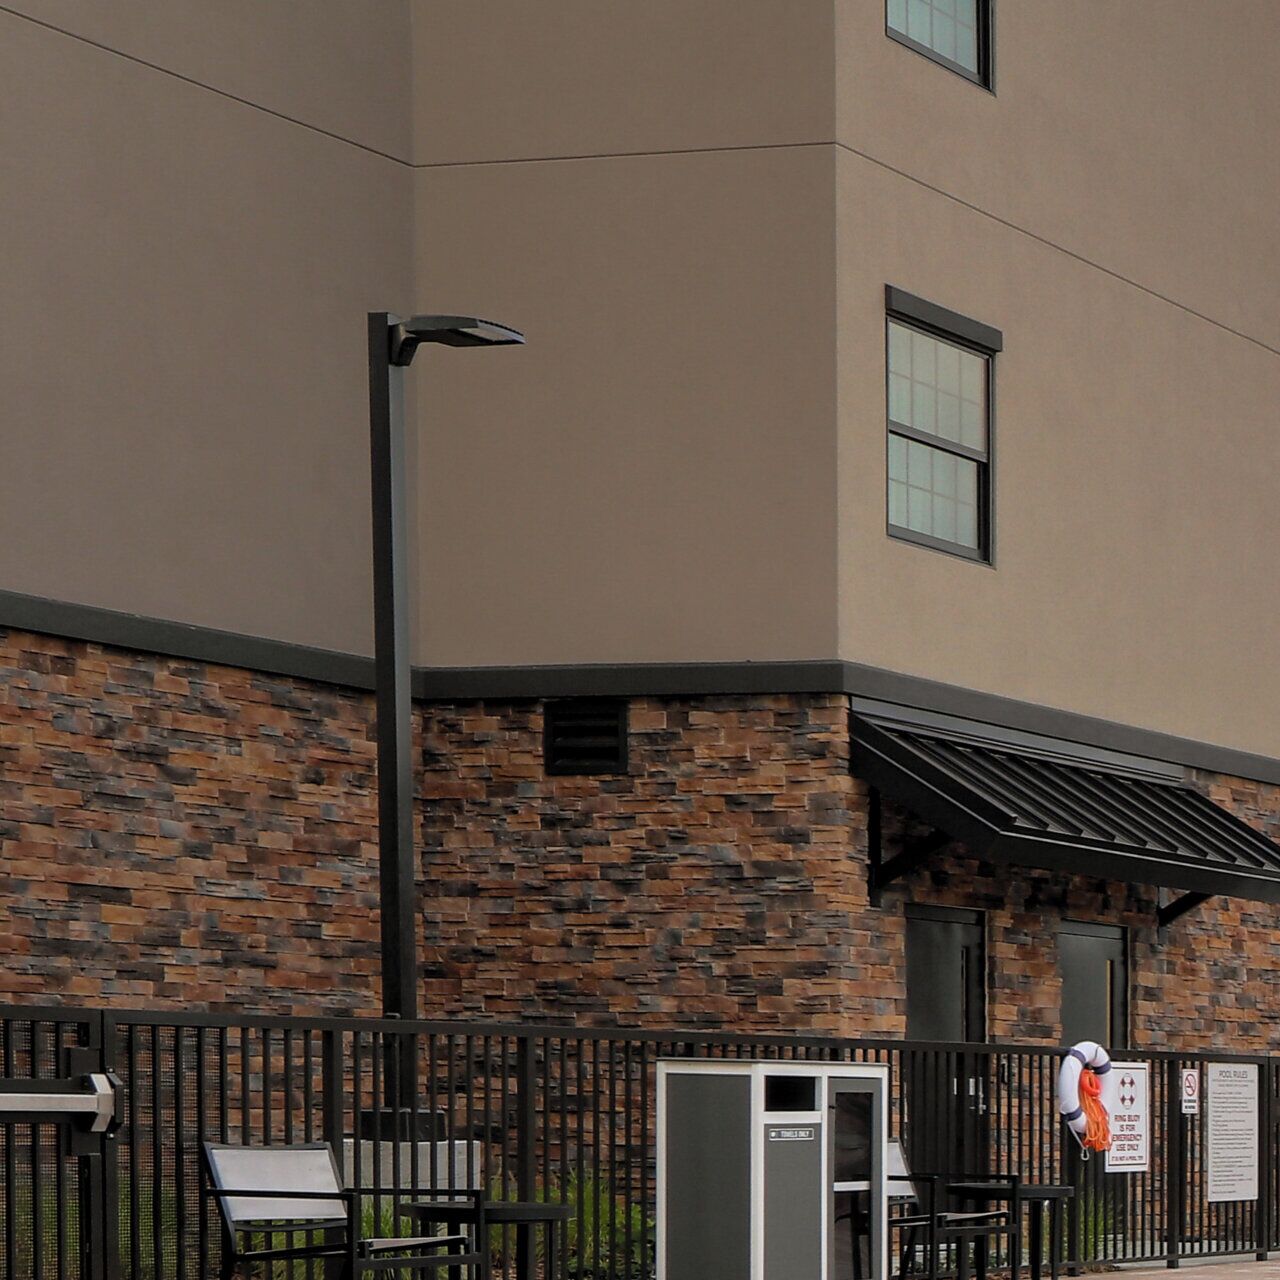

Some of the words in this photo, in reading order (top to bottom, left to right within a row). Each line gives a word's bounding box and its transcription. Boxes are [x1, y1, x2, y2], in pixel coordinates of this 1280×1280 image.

[1219, 1070, 1233, 1078] POOL
[1233, 1070, 1248, 1079] RULES
[1114, 1114, 1127, 1122] RING
[1127, 1114, 1140, 1122] BUOY
[1120, 1124, 1125, 1132] IS
[1112, 1133, 1142, 1142] EMERGENCY
[1116, 1143, 1126, 1151] USE
[1127, 1143, 1139, 1151] ONLY
